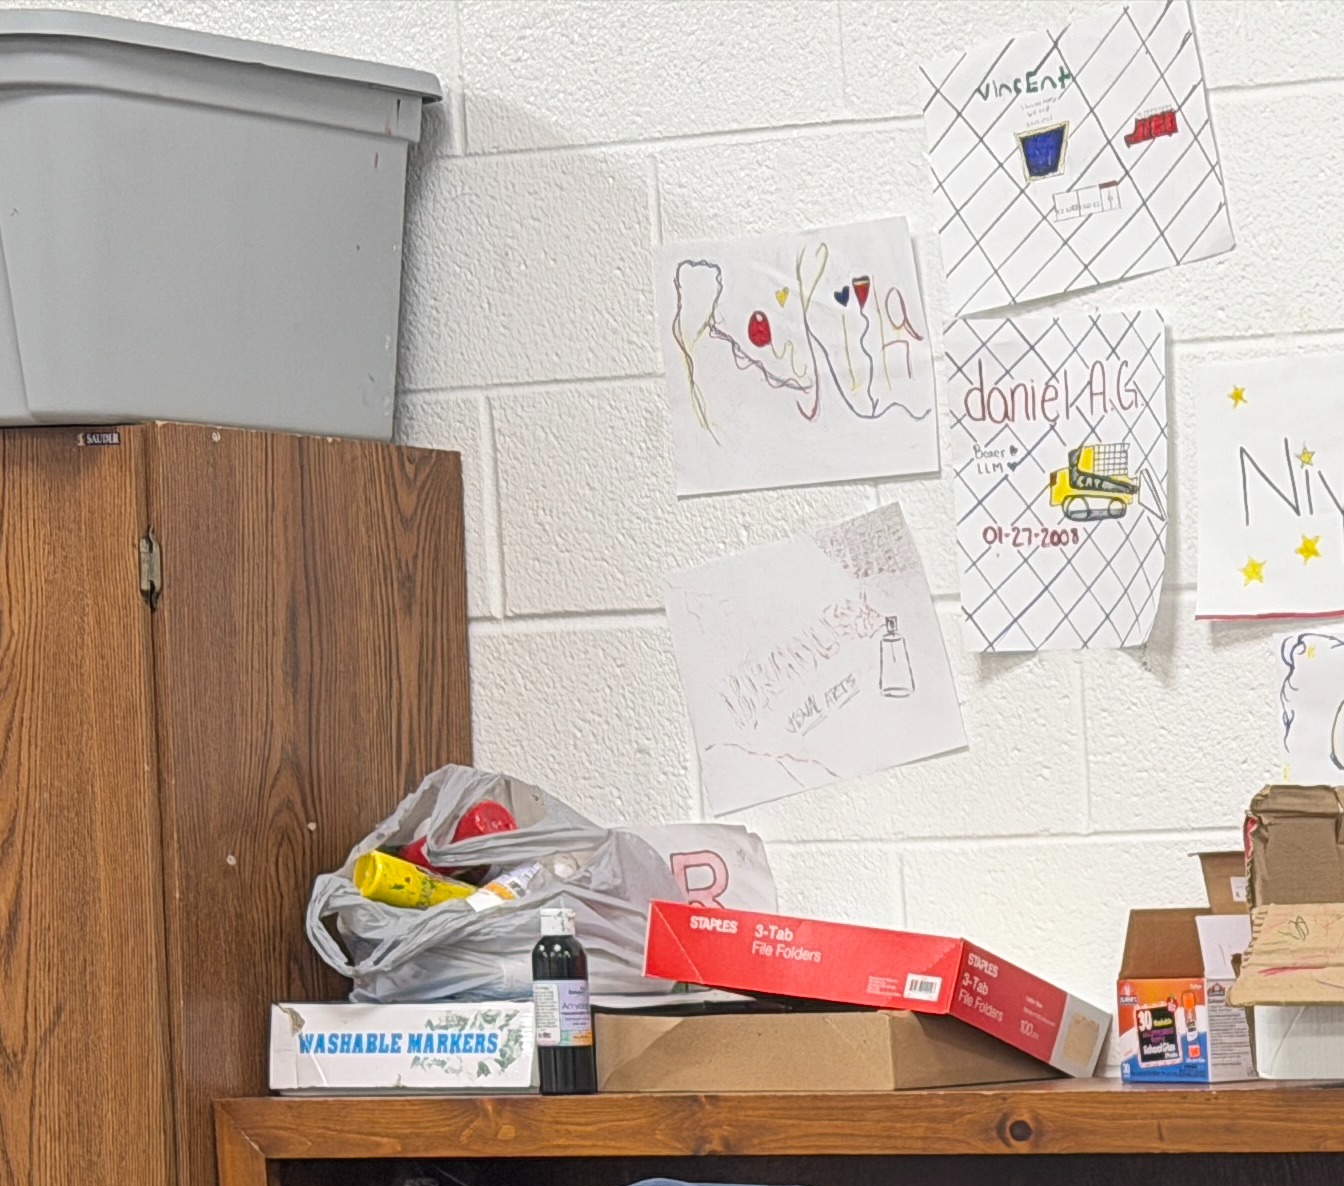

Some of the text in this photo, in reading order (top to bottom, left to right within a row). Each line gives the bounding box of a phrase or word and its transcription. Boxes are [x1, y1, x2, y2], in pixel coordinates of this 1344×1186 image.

[964, 358, 1070, 424] daniel
[690, 915, 739, 934] STAPLES
[754, 923, 794, 942] 3-Tab
[752, 940, 822, 963] File Folders
[967, 952, 999, 978] STAPLES
[962, 972, 989, 996] 3-Tab
[298, 1032, 499, 1055] WASHABLE MARKERS
